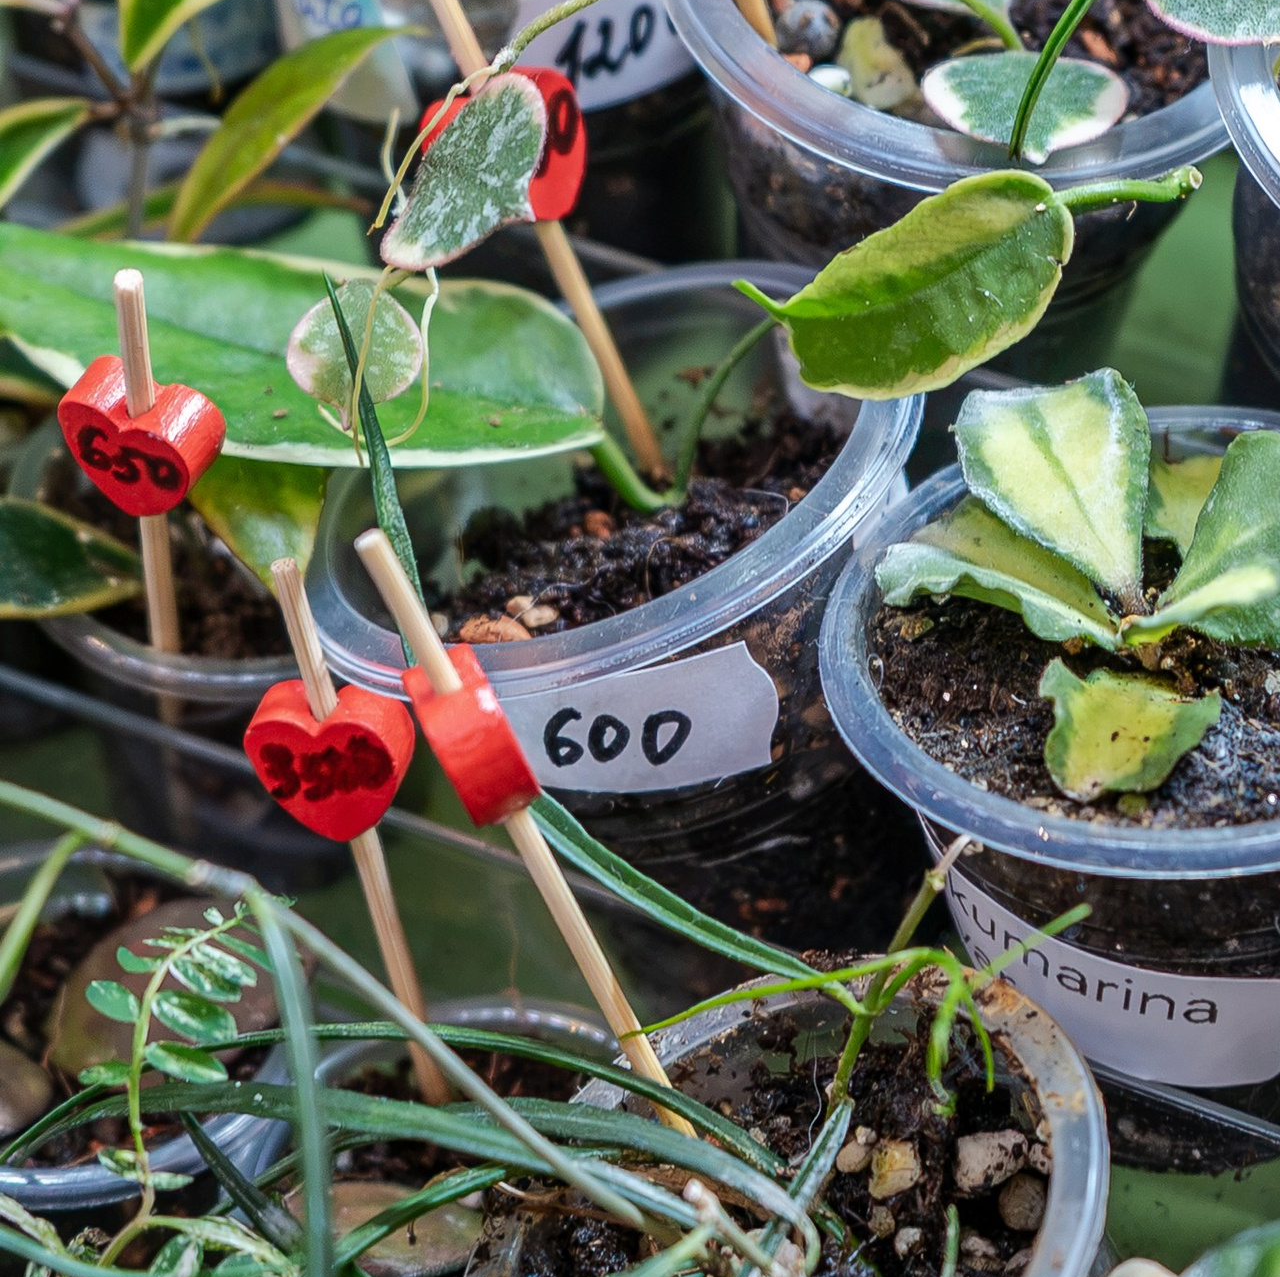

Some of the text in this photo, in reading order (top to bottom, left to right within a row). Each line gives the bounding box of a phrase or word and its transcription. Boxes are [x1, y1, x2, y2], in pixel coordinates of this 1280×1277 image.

[555, 2, 679, 88] 120
[76, 424, 183, 493] 650
[543, 706, 693, 769] 600
